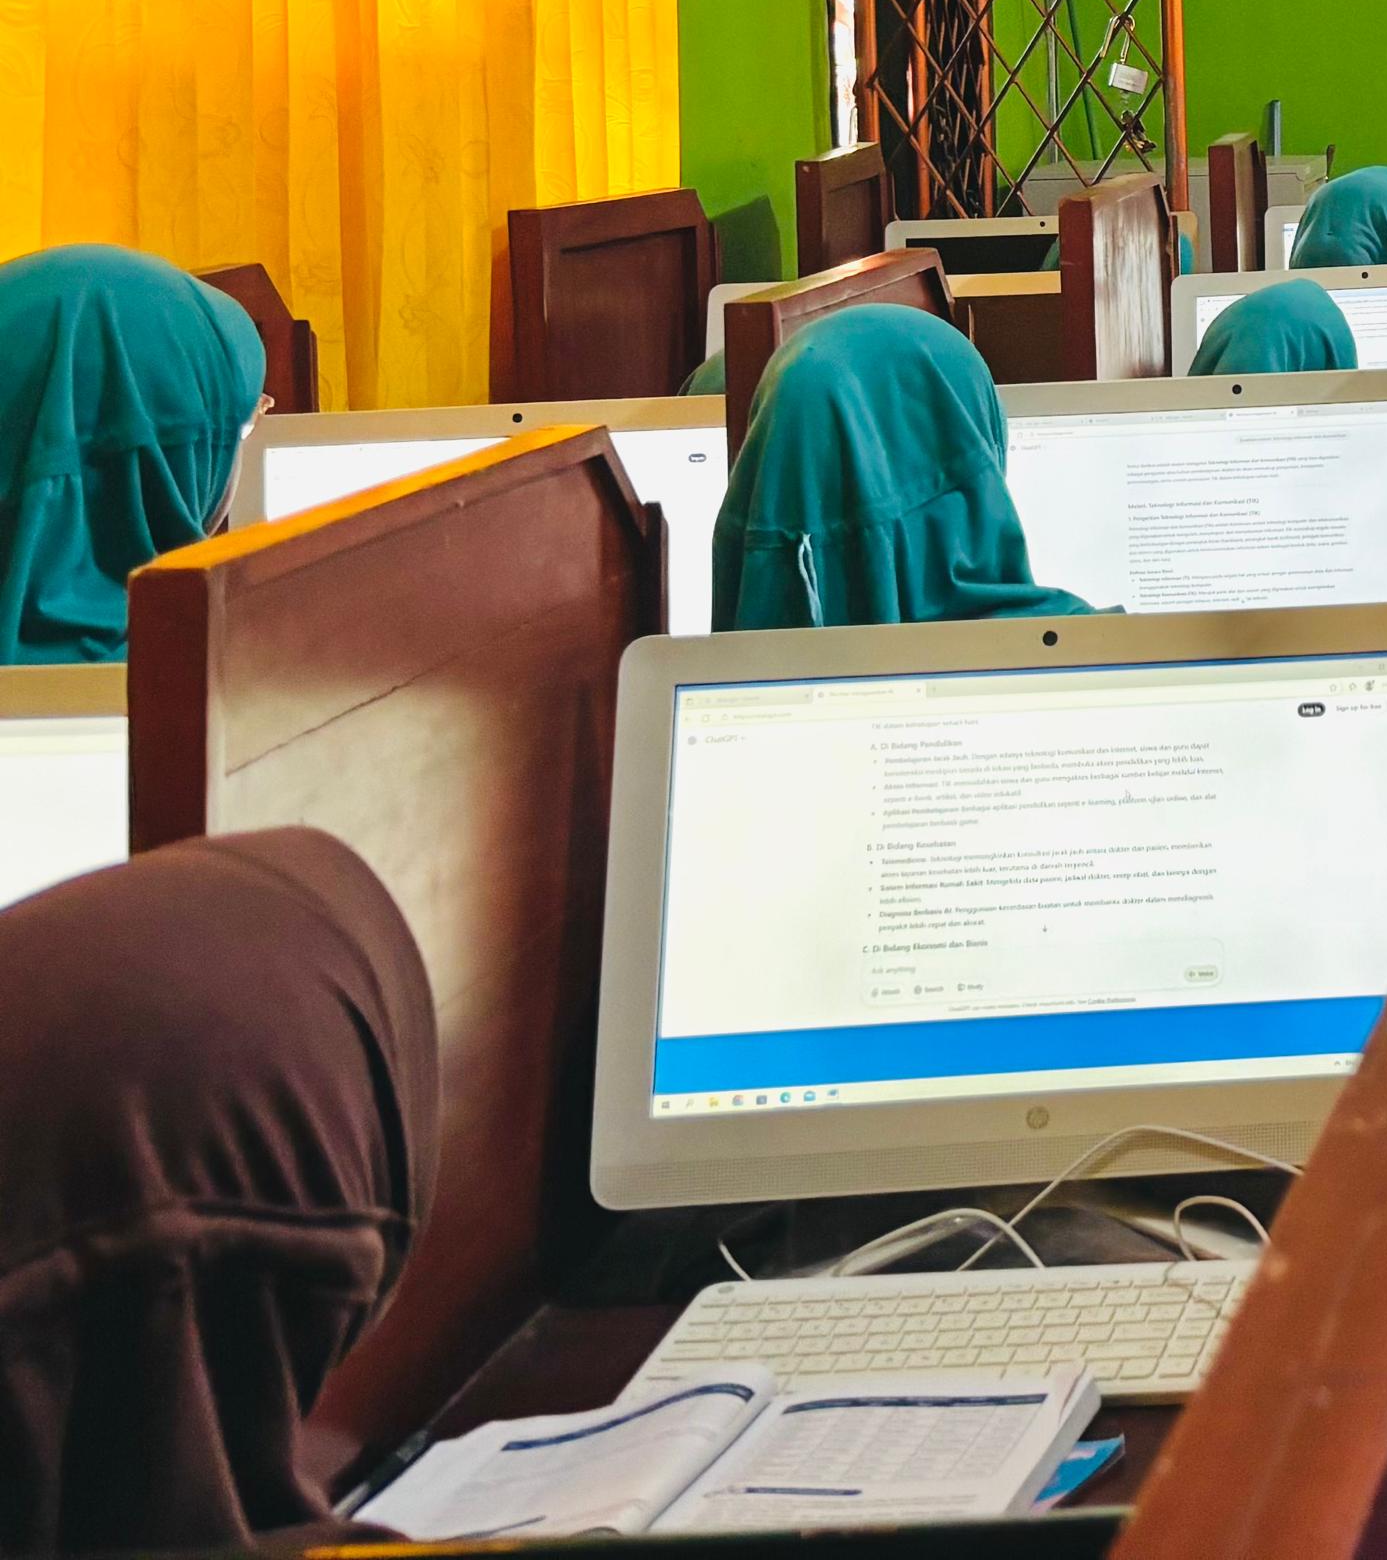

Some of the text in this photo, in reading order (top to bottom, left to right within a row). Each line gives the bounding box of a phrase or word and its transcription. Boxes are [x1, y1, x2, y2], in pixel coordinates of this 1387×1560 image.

[1302, 705, 1313, 715] Log
[705, 734, 738, 744] ChatGPT
[891, 742, 918, 751] Bidang
[888, 842, 914, 851] Bidang
[883, 944, 910, 953] Bidang
[886, 965, 916, 976] anything
